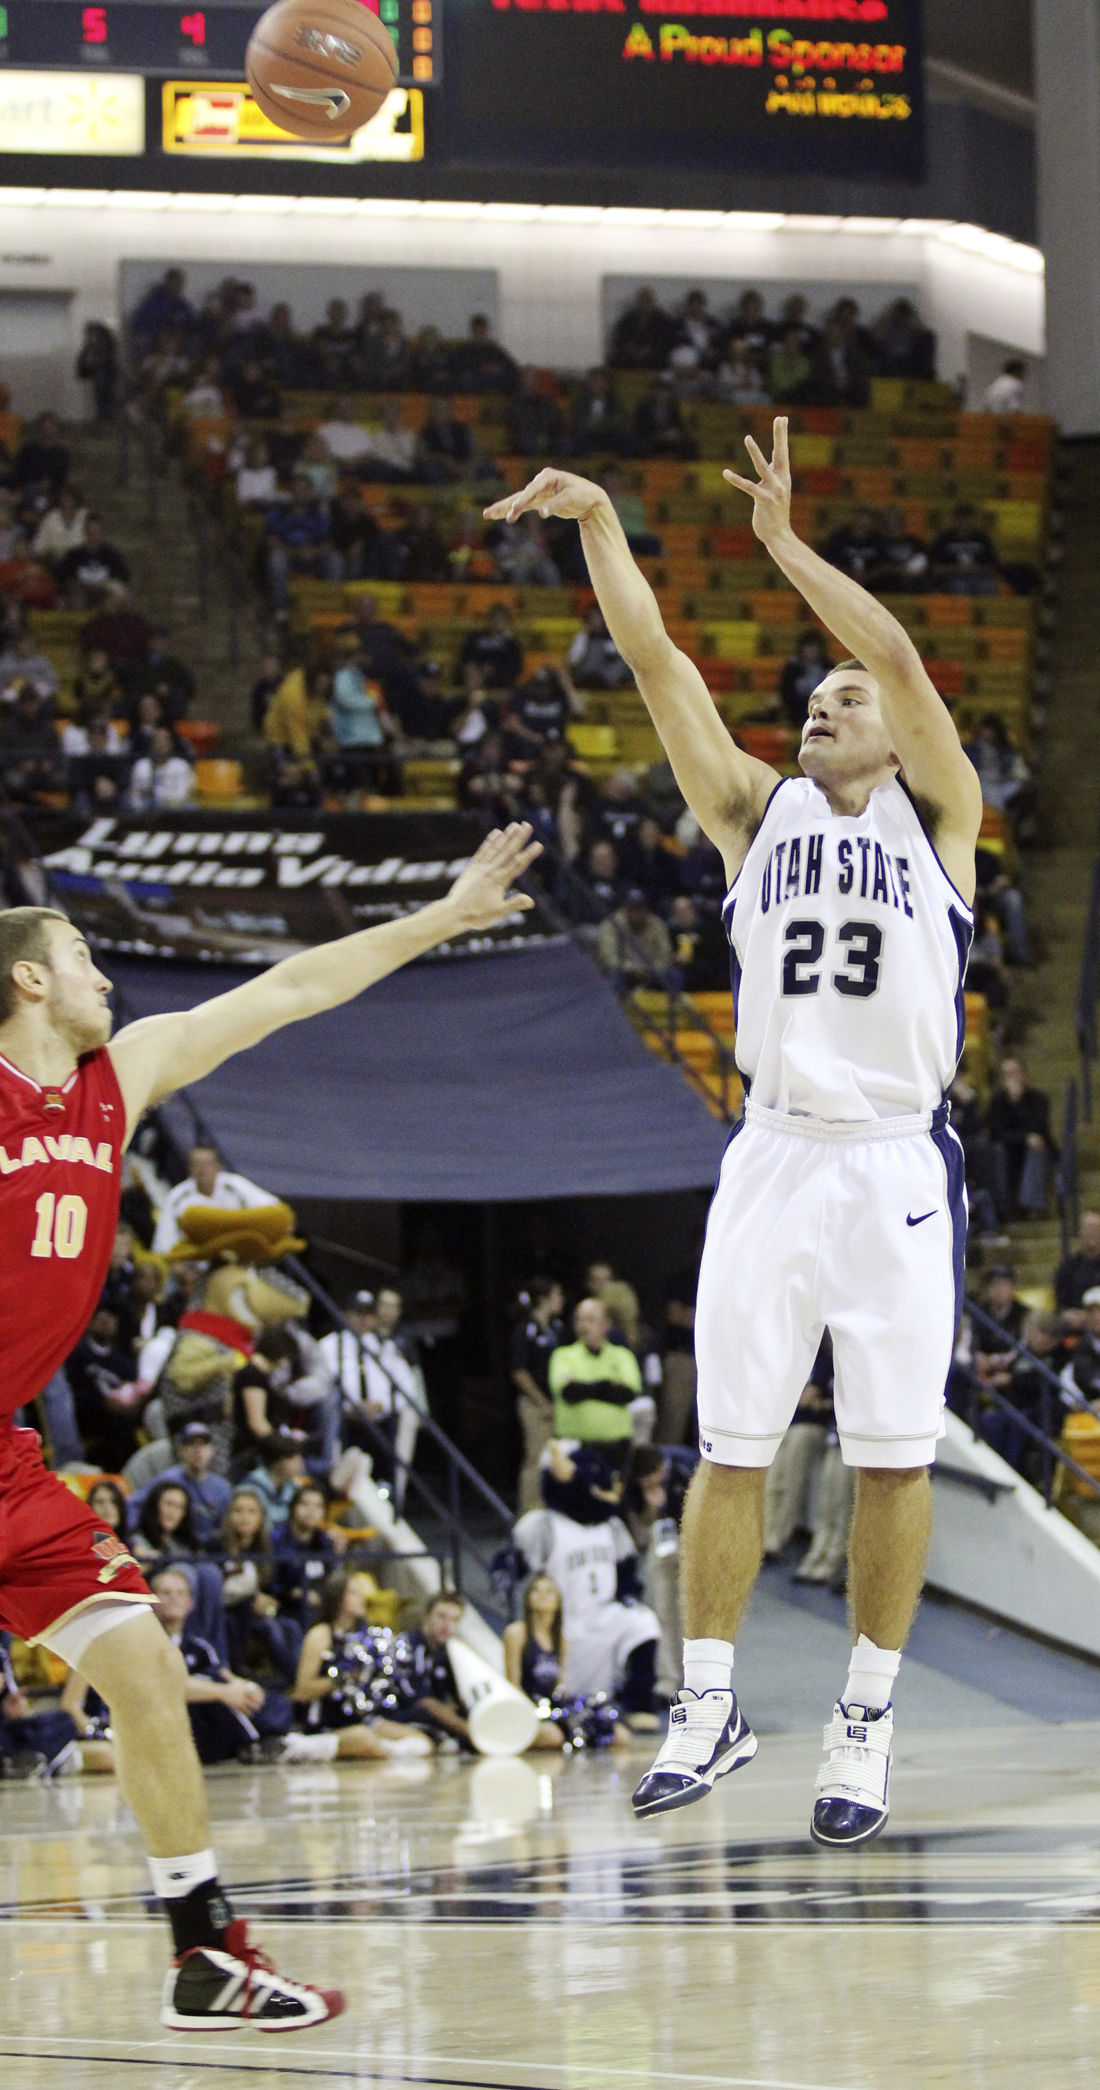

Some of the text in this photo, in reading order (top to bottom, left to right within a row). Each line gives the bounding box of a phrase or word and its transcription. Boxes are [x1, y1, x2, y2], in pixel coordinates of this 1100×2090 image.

[82, 7, 107, 43] 5
[180, 11, 206, 46] 4
[622, 22, 906, 73] A Proud Sponsor
[42, 846, 266, 887] Audio
[760, 833, 914, 920] UTAH STATE
[781, 917, 886, 1000] 23
[0, 1134, 114, 1175] LAVAL
[30, 1191, 88, 1259] 10
